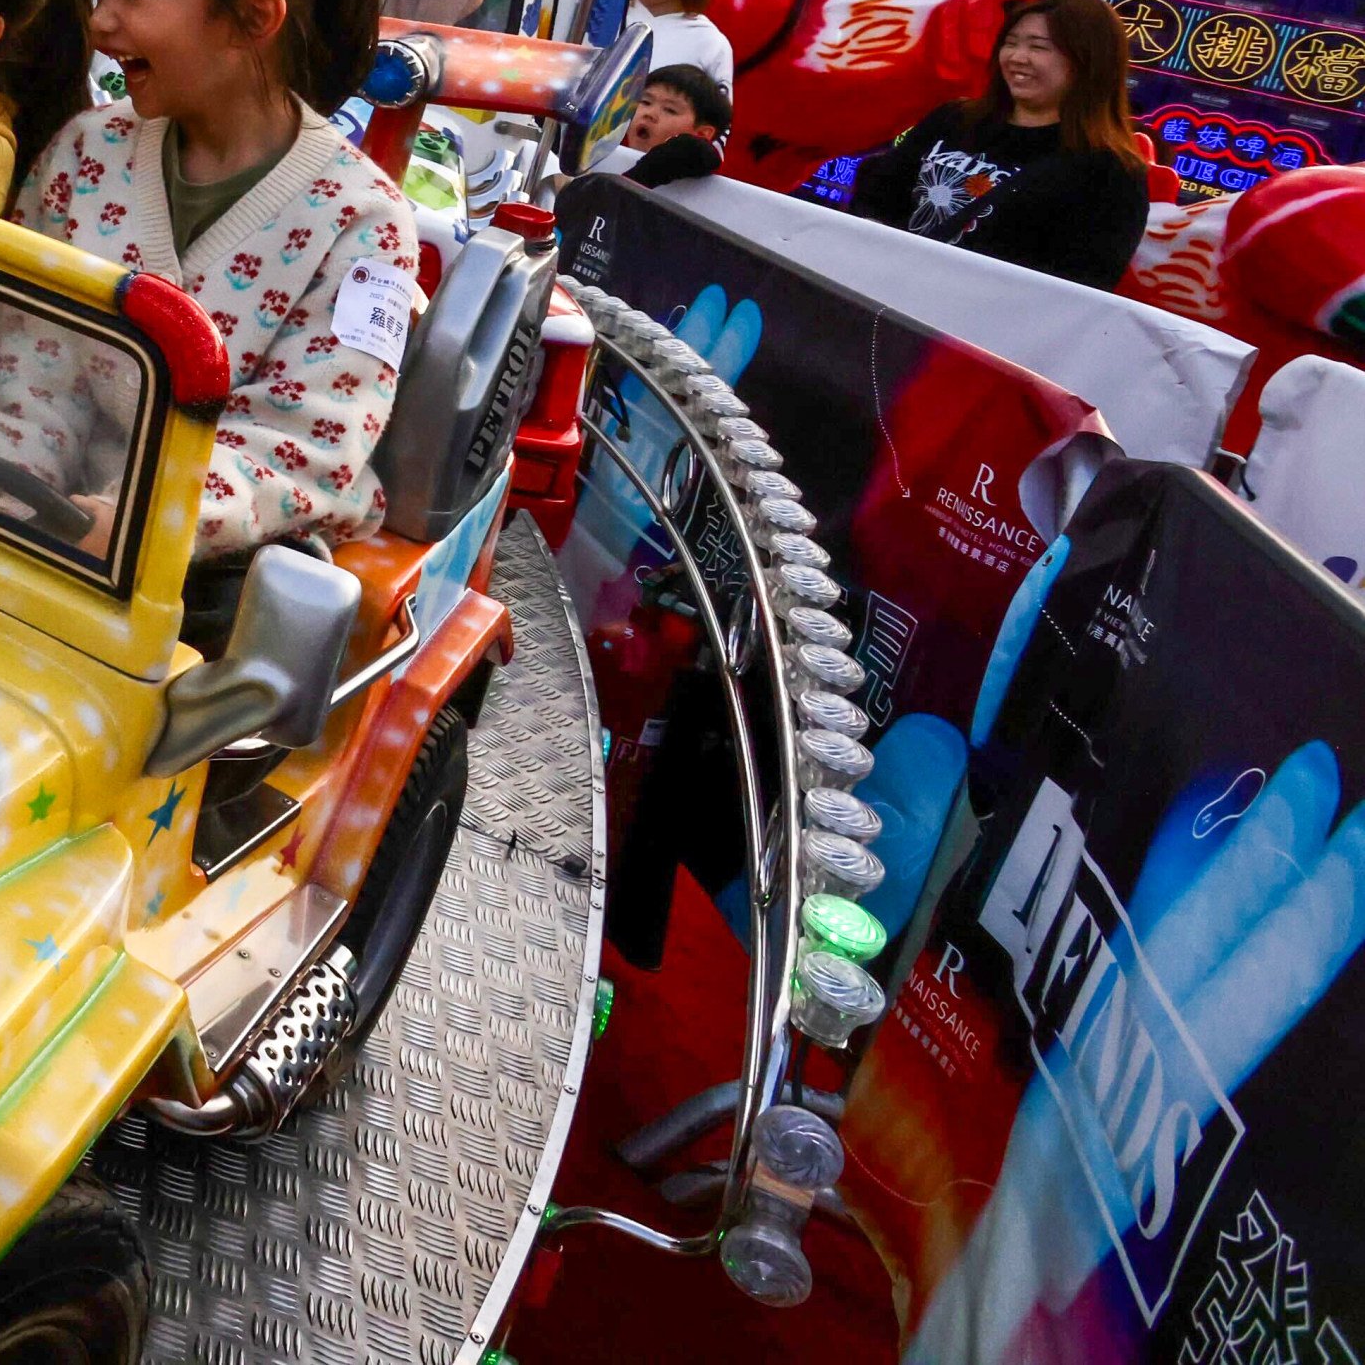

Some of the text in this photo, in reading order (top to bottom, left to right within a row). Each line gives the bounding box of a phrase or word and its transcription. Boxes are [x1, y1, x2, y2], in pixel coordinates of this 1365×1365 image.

[1120, 2, 1365, 96] 大排檔
[1163, 119, 1304, 170] 藍妹啤酒
[588, 216, 605, 243] R
[468, 327, 535, 469] PETROL
[970, 463, 997, 506] R
[932, 941, 965, 1000] R
